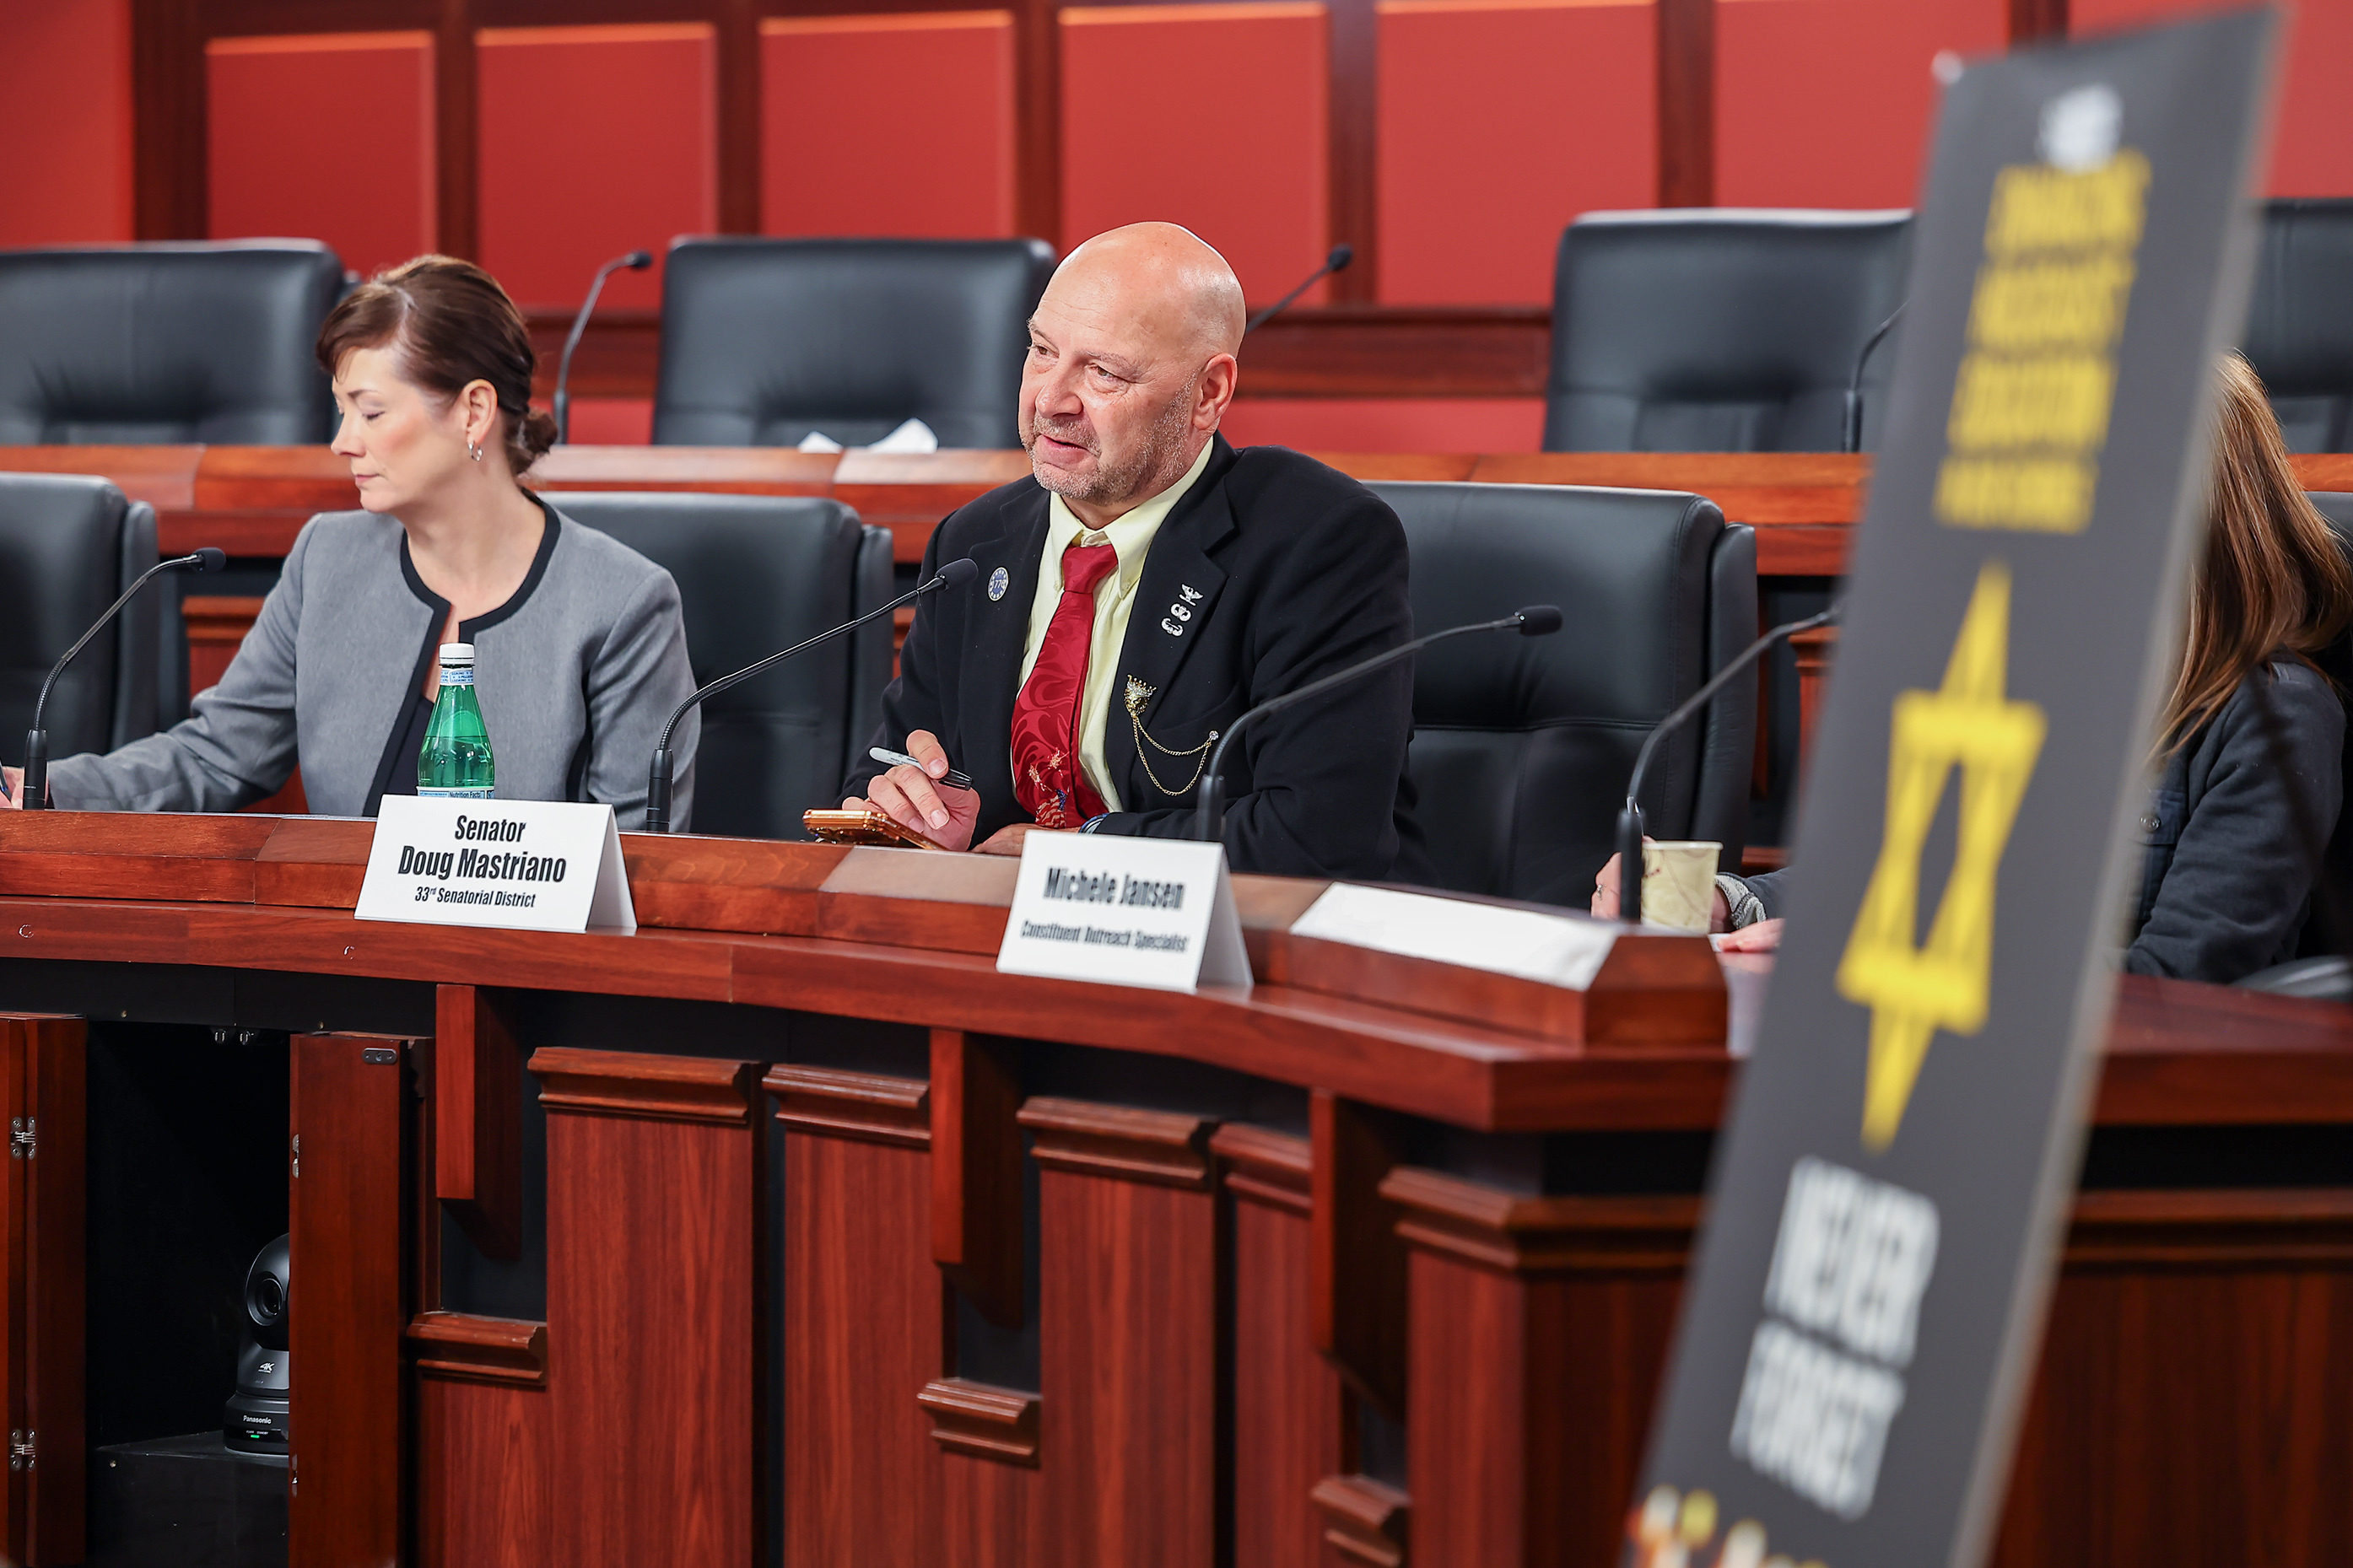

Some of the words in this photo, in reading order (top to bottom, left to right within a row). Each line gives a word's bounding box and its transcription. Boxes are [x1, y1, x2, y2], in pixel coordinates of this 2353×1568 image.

[455, 815, 526, 843] Senator
[398, 845, 454, 880] Doug
[456, 849, 566, 882] Mastriano
[414, 886, 437, 902] 33rd
[437, 888, 493, 905] Senatorial
[494, 892, 536, 908] District
[1044, 867, 1116, 903] Michele
[1120, 874, 1184, 908] Jansen
[1023, 920, 1081, 942] Constituent
[1763, 1156, 1940, 1370] NEVER
[259, 1362, 275, 1371] 4K
[243, 1414, 272, 1425] Panasonic
